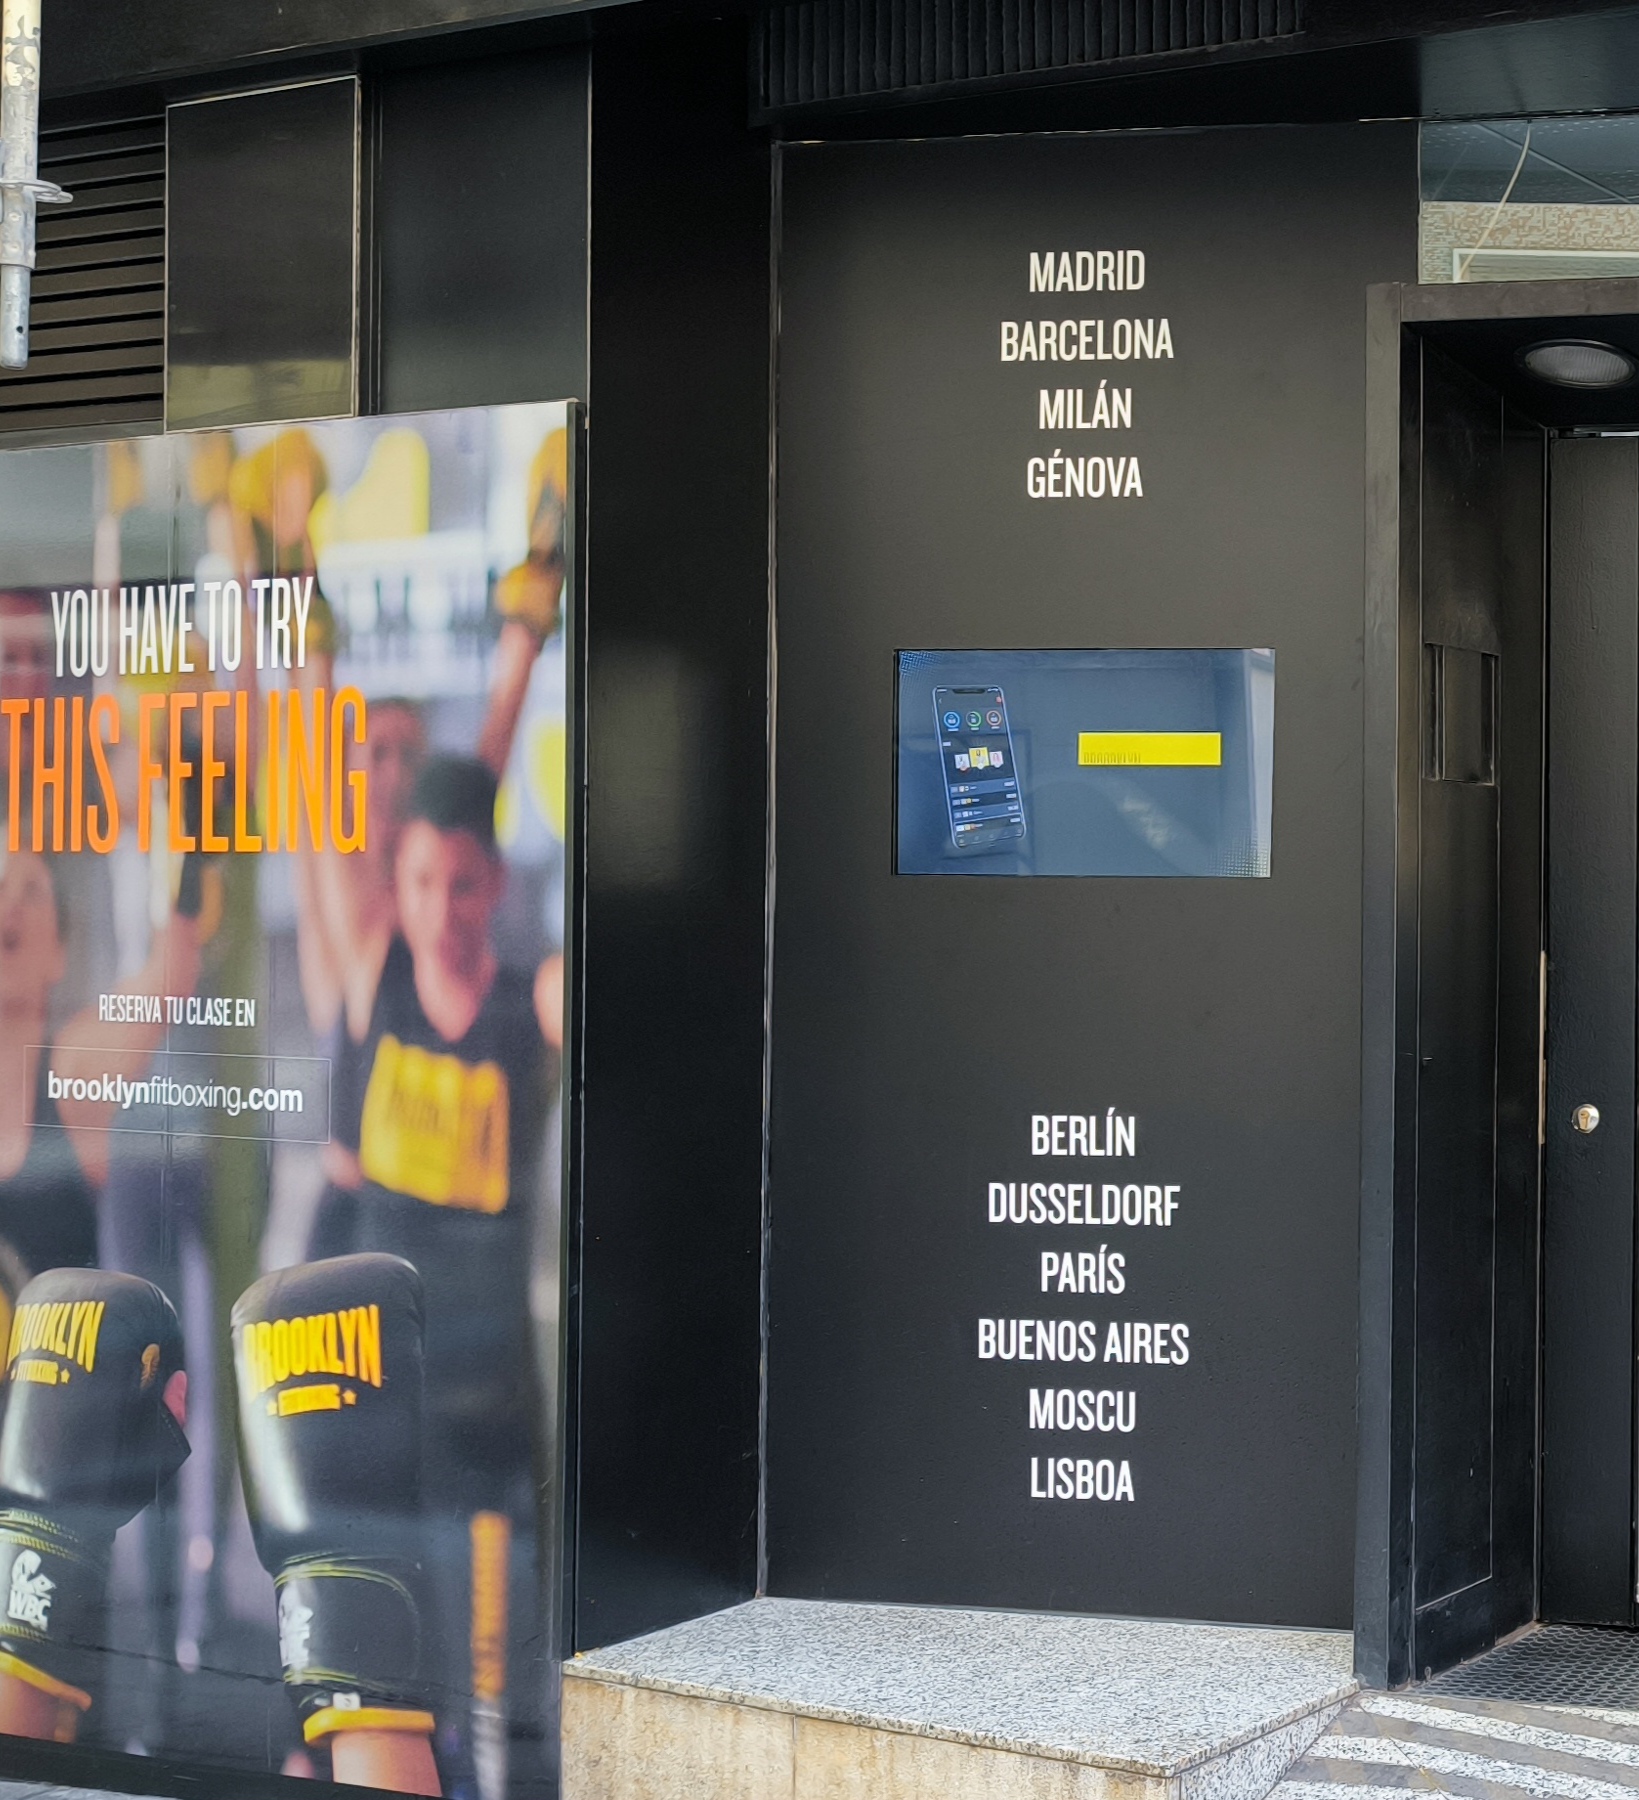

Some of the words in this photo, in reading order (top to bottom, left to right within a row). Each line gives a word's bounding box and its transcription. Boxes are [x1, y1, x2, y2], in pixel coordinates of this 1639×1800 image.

[1029, 249, 1146, 292] MADRID
[1000, 318, 1174, 362] BARCELONA
[1038, 379, 1132, 430] MILÁN
[1026, 448, 1144, 499] GÉNOVA
[51, 588, 109, 678] YOU
[119, 583, 195, 675] HAVE
[204, 579, 243, 672] TO
[251, 576, 314, 669] TRY
[0, 694, 121, 854] THIS
[137, 684, 368, 855] FEELING
[99, 994, 162, 1023] RESERVA
[164, 996, 183, 1024] TU
[186, 997, 232, 1026] CLASE
[235, 999, 256, 1027] EN
[47, 1071, 303, 1116] brooklynfitboxing.com
[1031, 1107, 1136, 1156] BERLÍN
[988, 1182, 1181, 1227] DUSSELDORF
[1040, 1244, 1126, 1295] PARÍS
[977, 1318, 1097, 1363] BUENOS
[1103, 1322, 1190, 1366] AIRES
[1028, 1388, 1136, 1434] MOSCU
[1030, 1457, 1135, 1502] LISBOA
